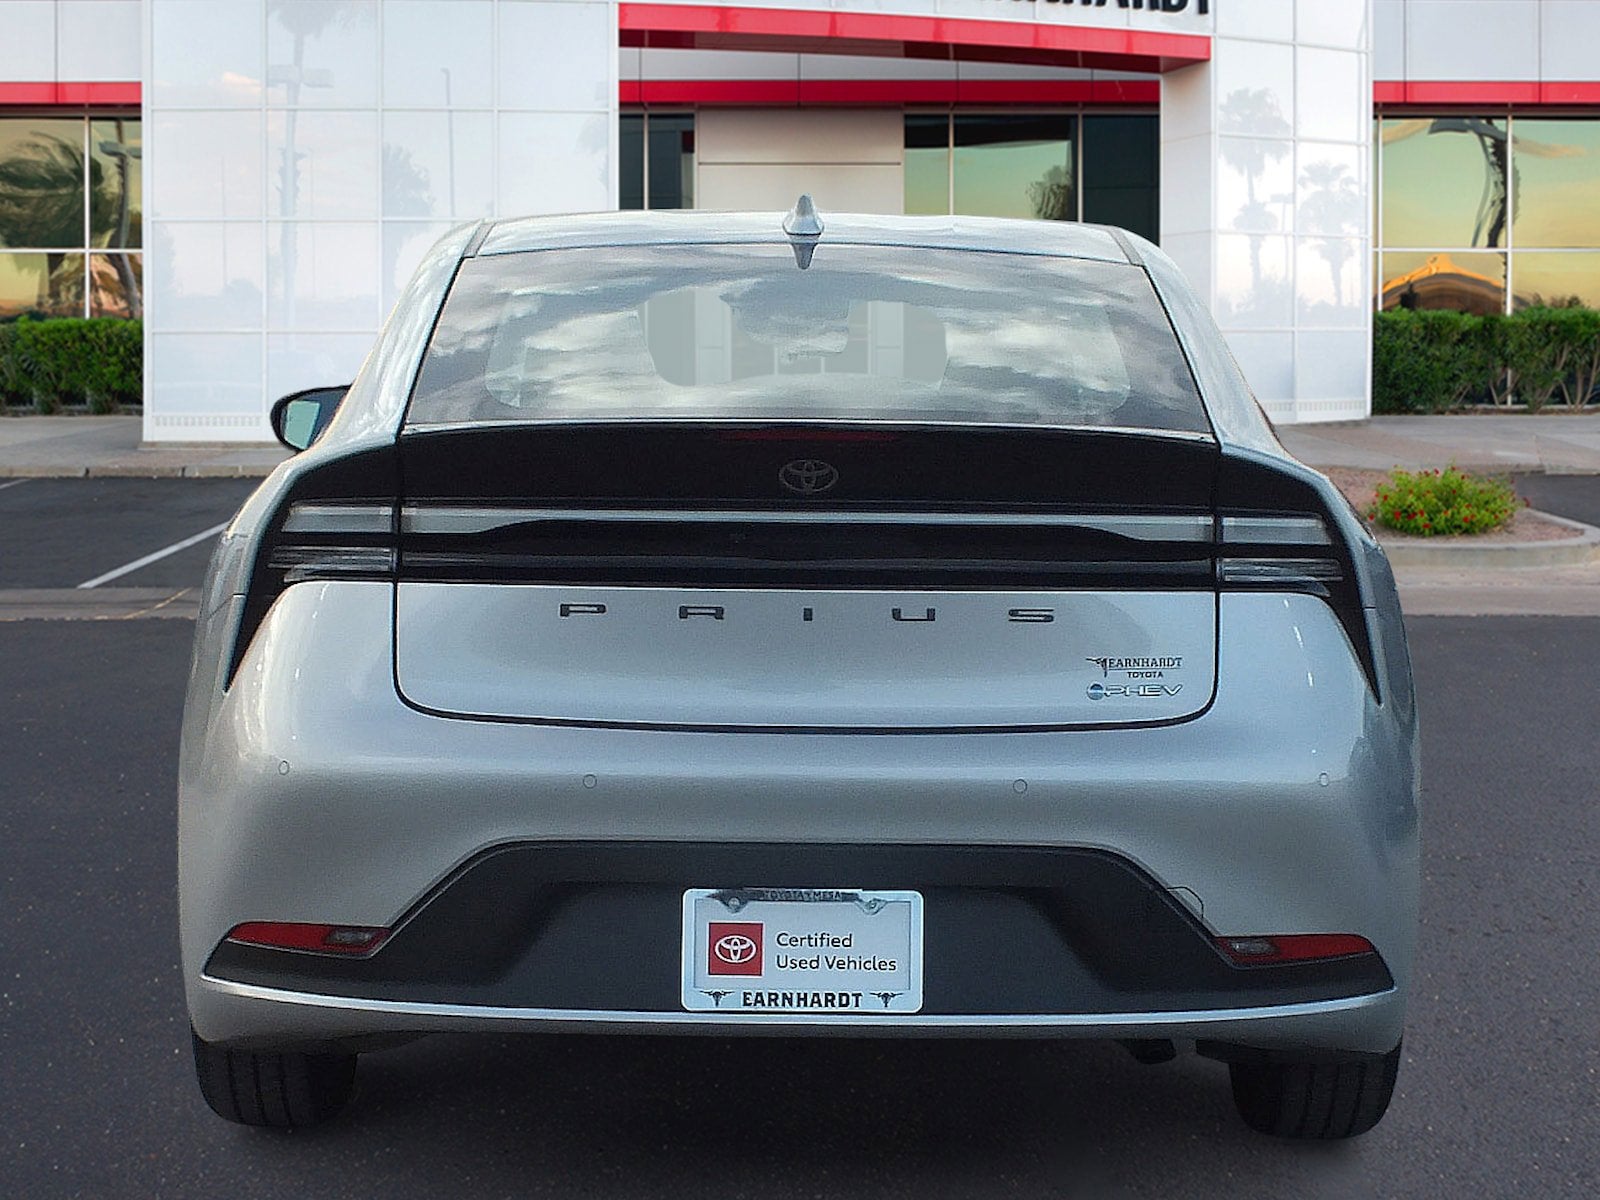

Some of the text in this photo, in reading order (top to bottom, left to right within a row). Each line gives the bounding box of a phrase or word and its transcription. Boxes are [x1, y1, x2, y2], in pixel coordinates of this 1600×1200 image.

[559, 603, 1055, 623] PRIUS
[1108, 658, 1182, 668] EARNHARDT
[1105, 684, 1183, 697] PHEV
[763, 890, 841, 900] TOYOTA MESA
[776, 932, 853, 948] Certified
[776, 955, 897, 971] Used Vehicles
[742, 991, 863, 1008] EARNHARDT
